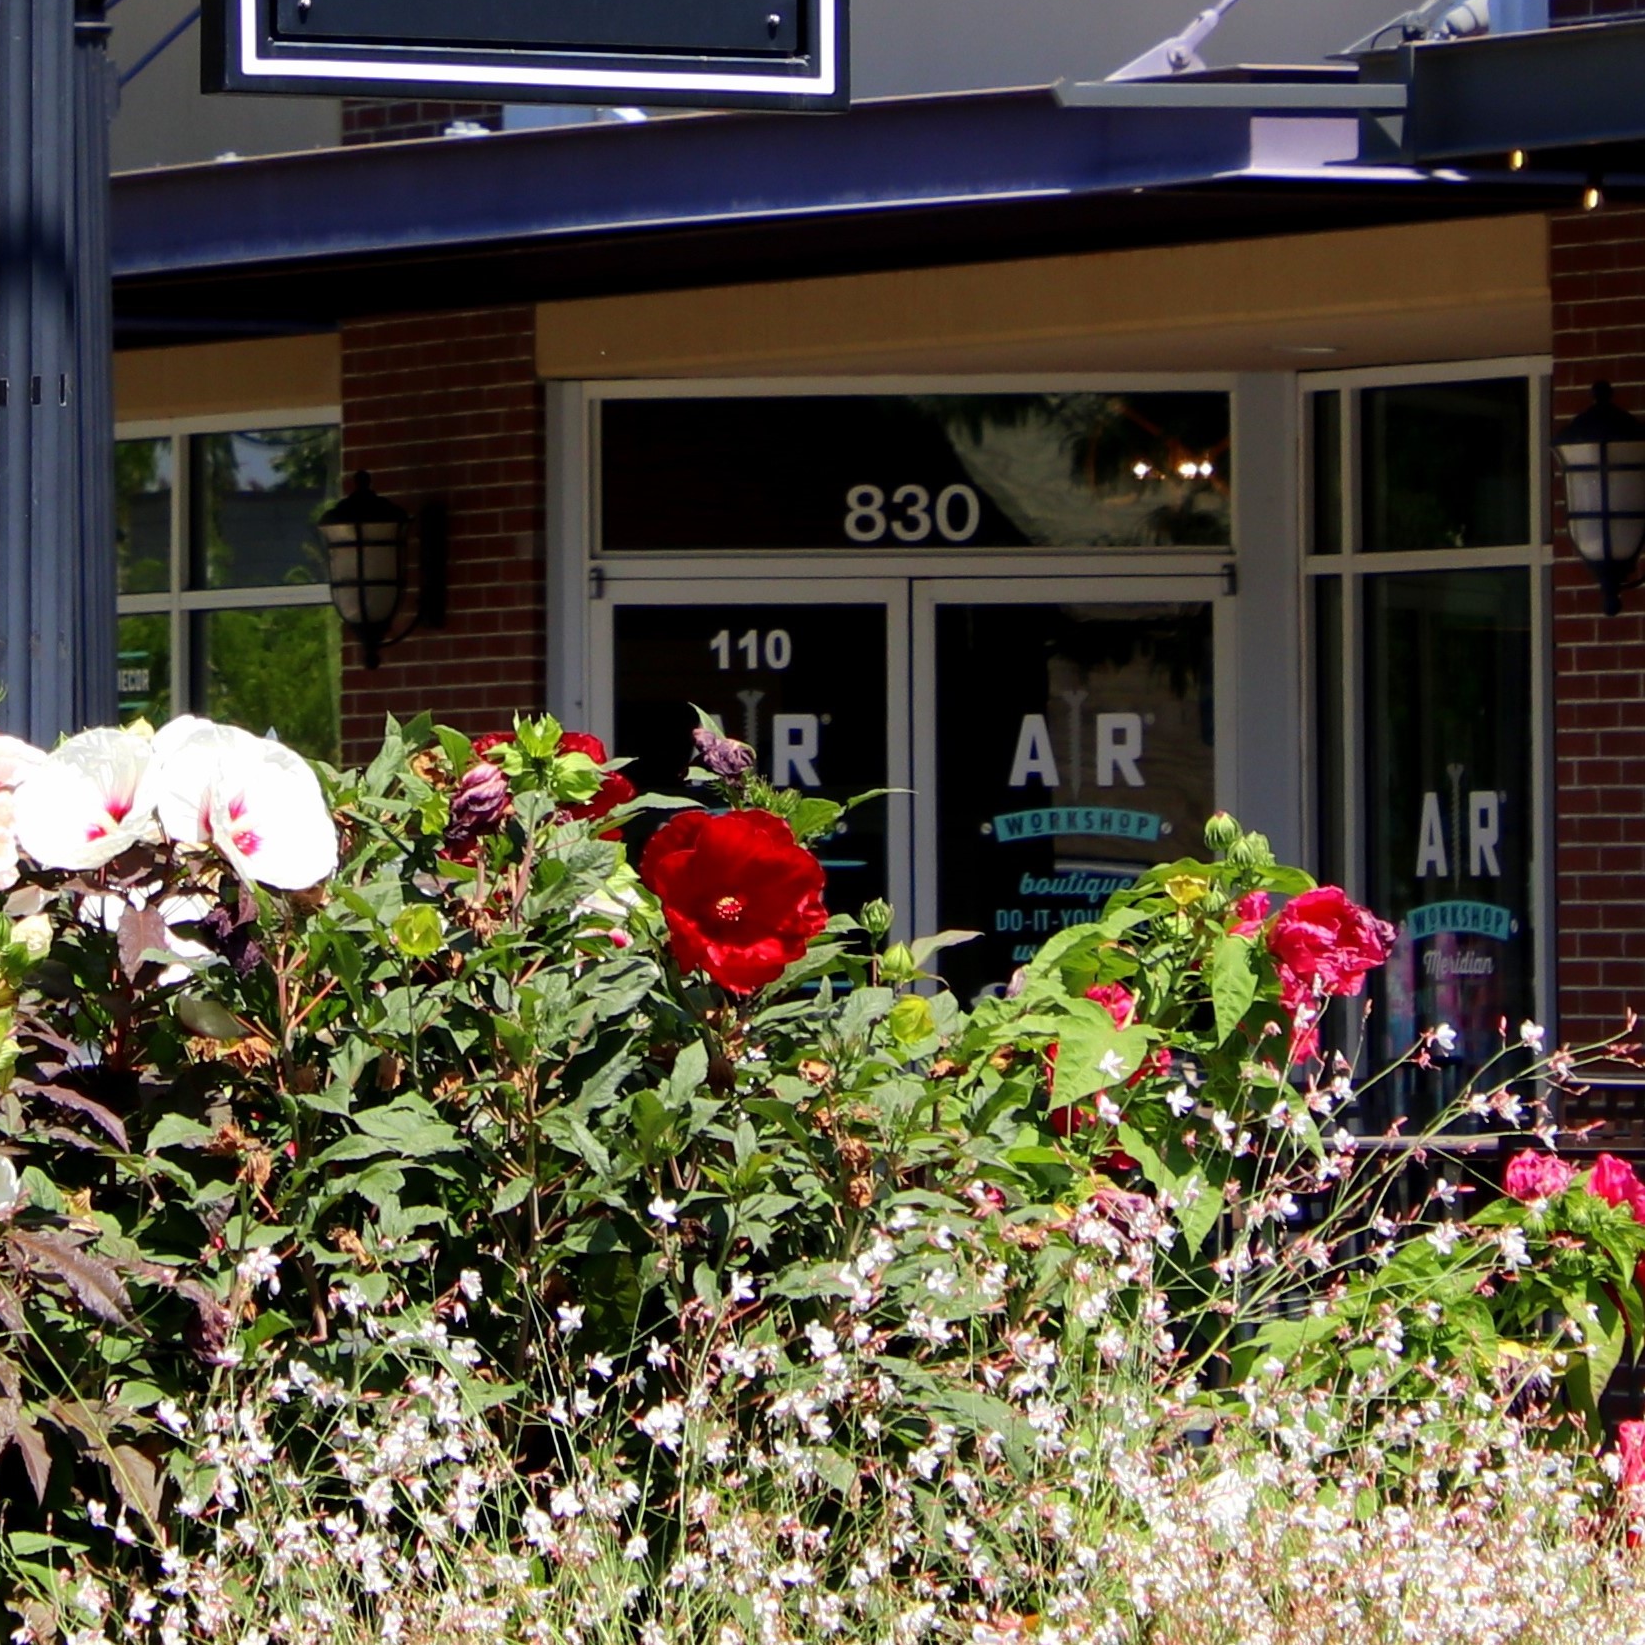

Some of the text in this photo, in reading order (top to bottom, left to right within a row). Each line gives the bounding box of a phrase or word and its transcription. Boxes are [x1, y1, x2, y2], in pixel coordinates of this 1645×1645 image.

[844, 483, 980, 542] 830
[709, 629, 792, 670] 110
[1005, 810, 1151, 837] WORKSHOP
[1019, 871, 1133, 904] boutique
[995, 908, 1101, 932] DO-IT-YOU
[1413, 906, 1503, 934] WORKSHOP
[1422, 949, 1495, 980] Meridian
